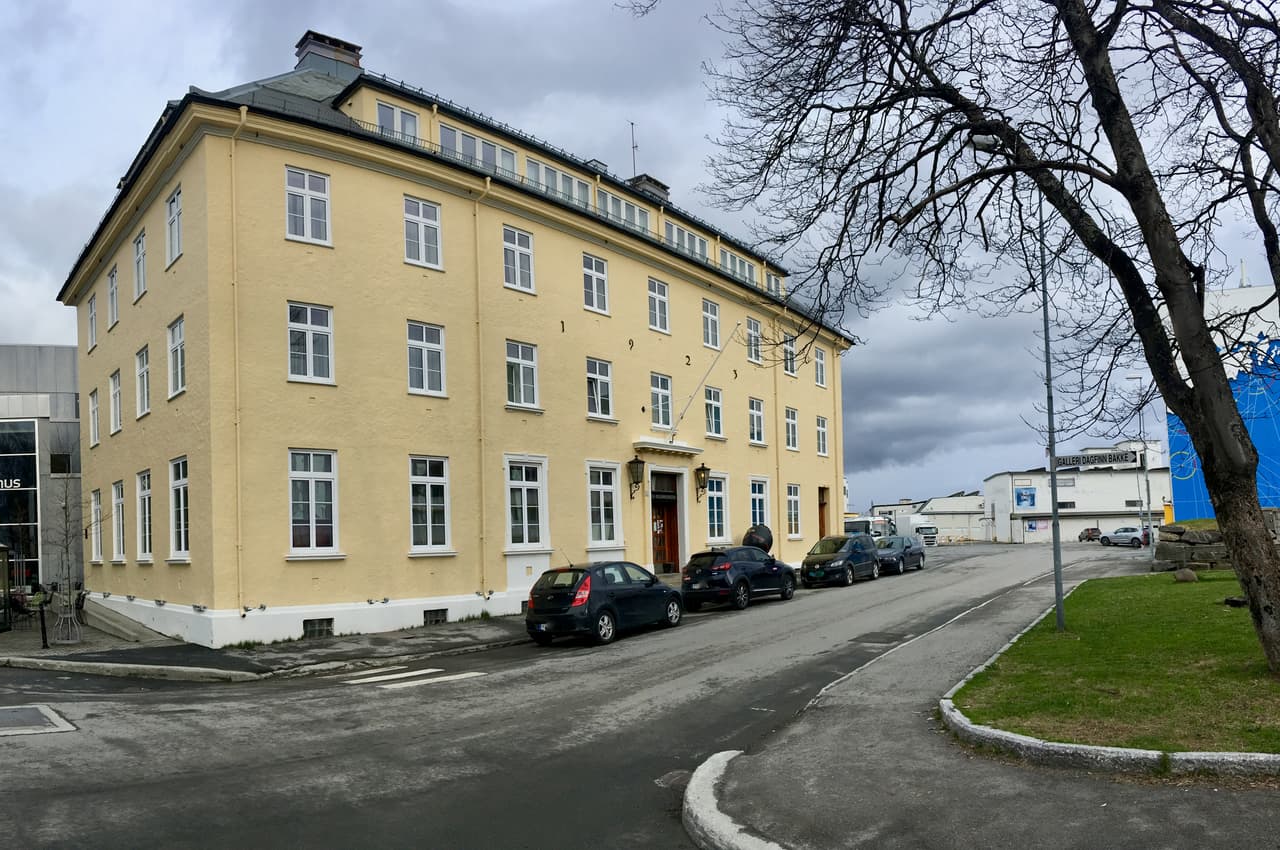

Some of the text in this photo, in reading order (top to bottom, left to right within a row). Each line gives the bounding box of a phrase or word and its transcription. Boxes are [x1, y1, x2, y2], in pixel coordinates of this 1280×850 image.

[1057, 452, 1129, 466] GALLERI DAGFINN BAKKE
